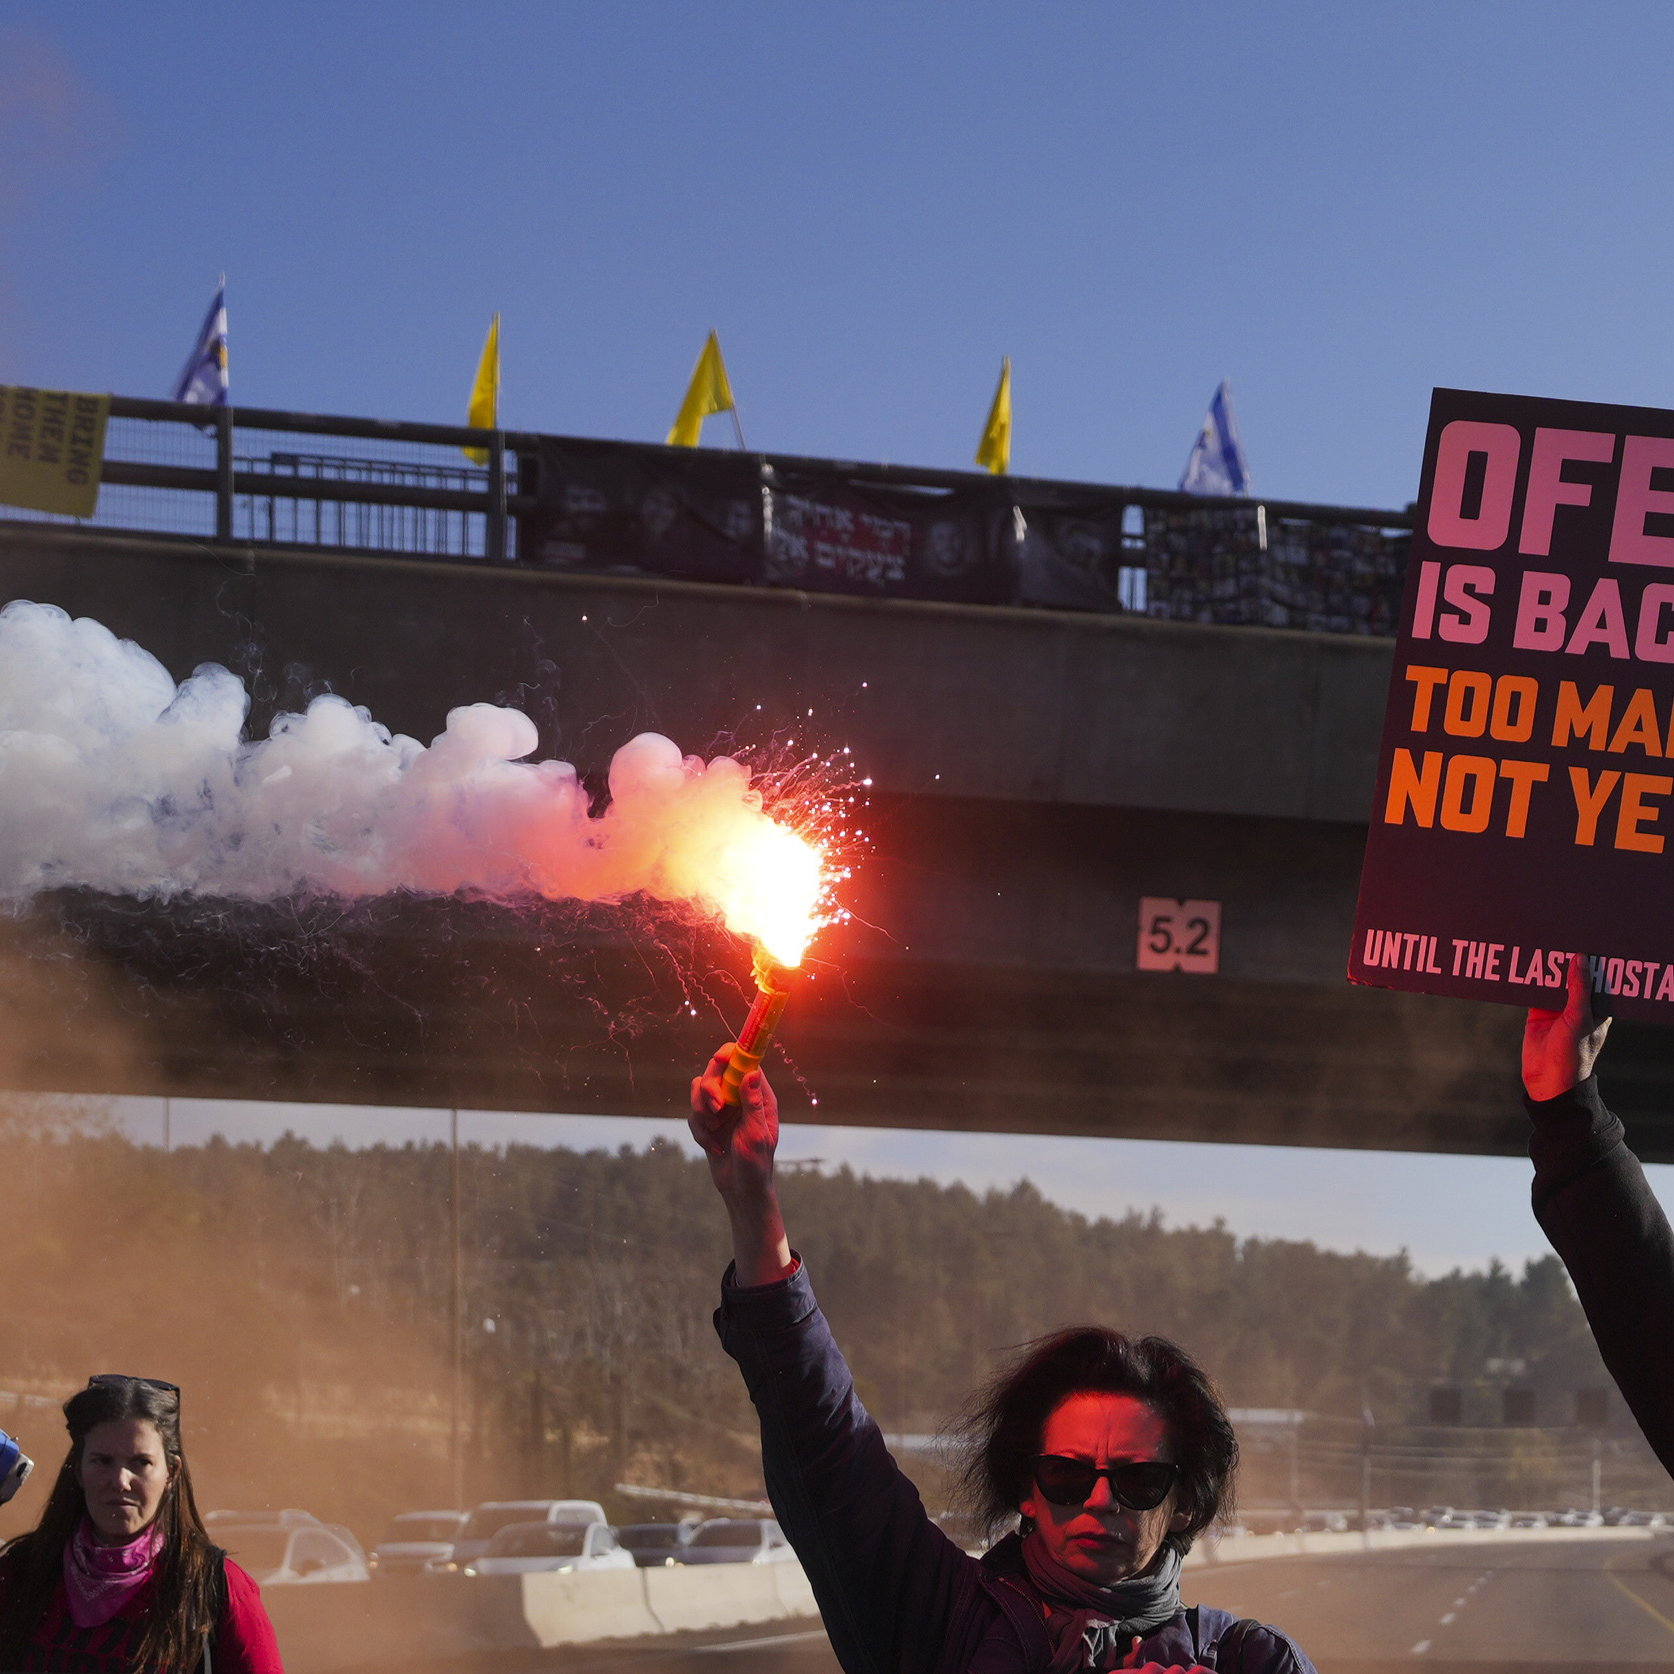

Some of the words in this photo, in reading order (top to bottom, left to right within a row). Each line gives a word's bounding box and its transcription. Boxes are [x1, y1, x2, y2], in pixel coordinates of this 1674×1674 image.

[38, 392, 70, 464] THEM
[66, 396, 100, 486] BRING
[1411, 560, 1496, 645] IS
[1405, 664, 1539, 743] TOO
[1384, 748, 1550, 839] NOT
[1149, 916, 1210, 956] 5.2
[1363, 928, 1442, 974] UNTIL
[1451, 938, 1505, 982] THE
[1508, 946, 1577, 989] LAS
